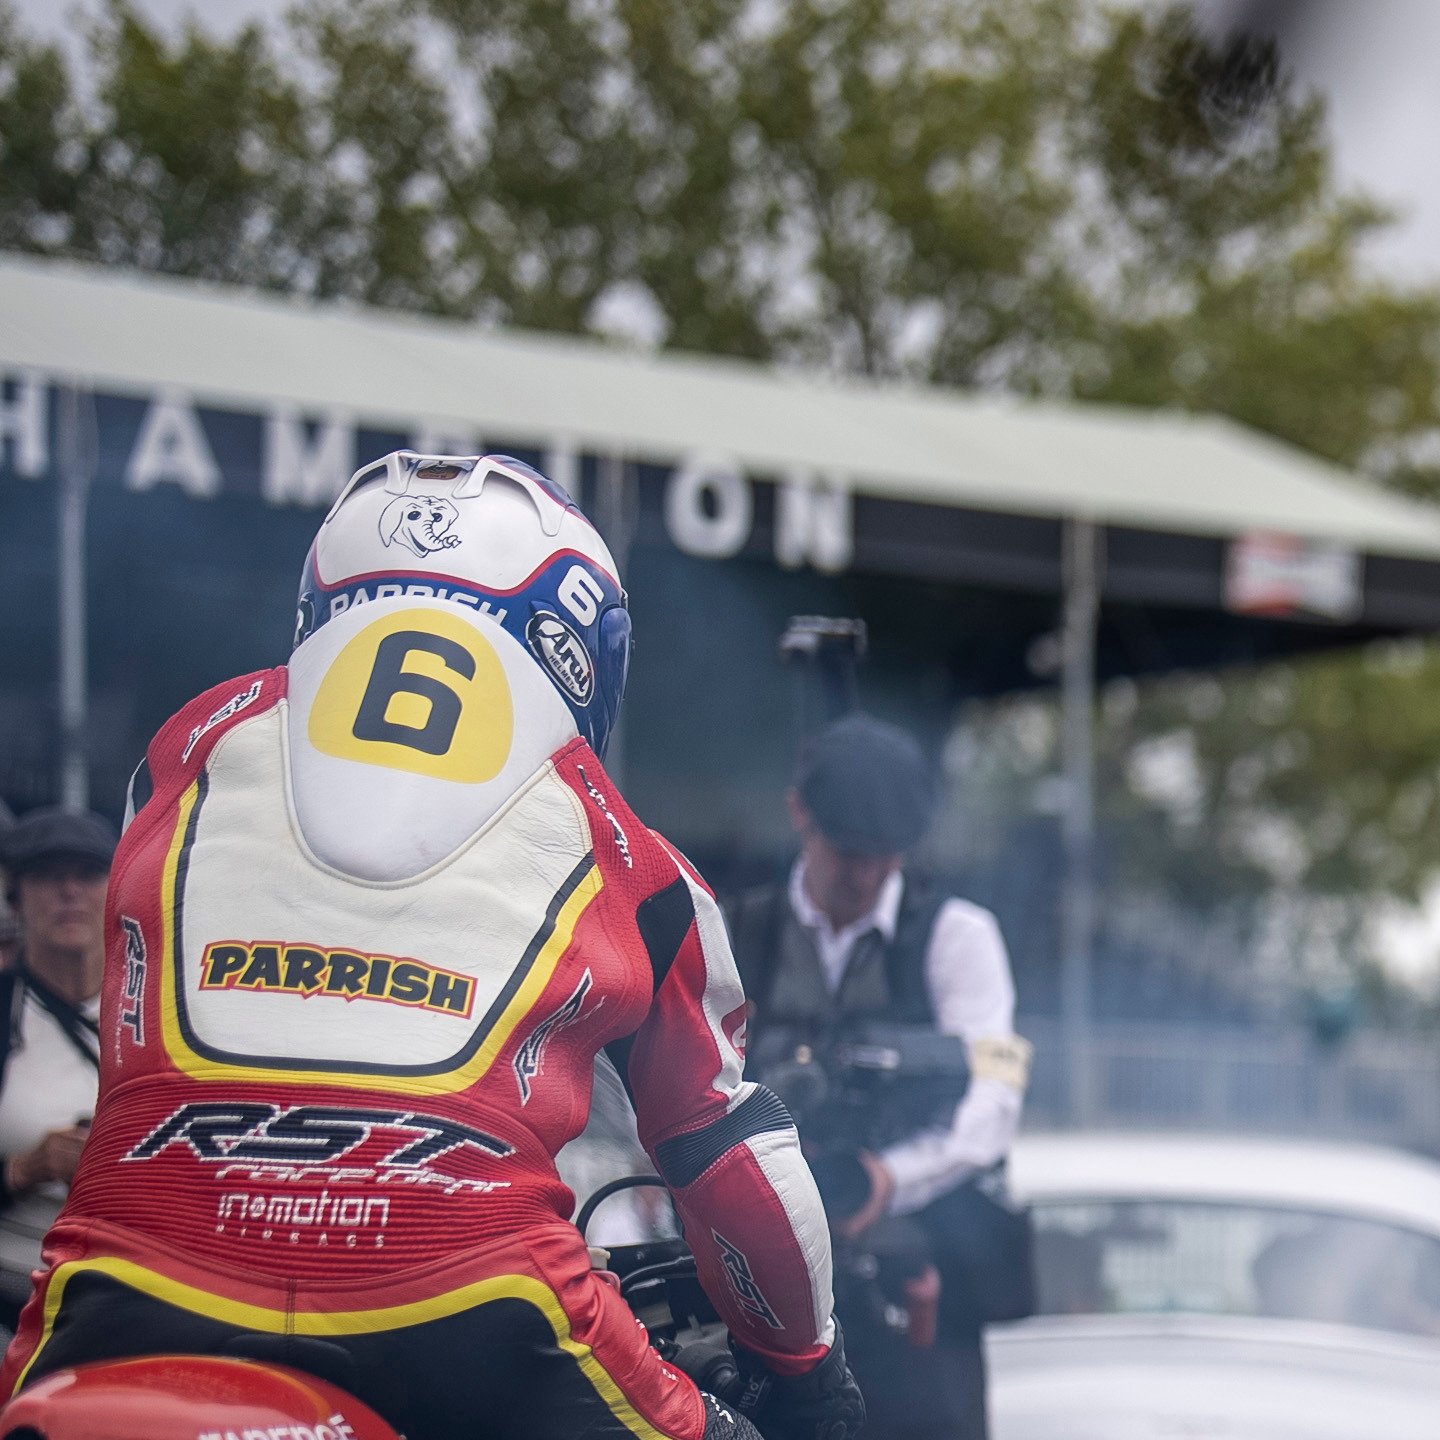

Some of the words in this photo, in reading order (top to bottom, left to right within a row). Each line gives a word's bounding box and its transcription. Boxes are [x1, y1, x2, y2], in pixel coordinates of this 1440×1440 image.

[0, 372, 855, 574] HAMON
[557, 564, 605, 627] 6
[351, 630, 479, 756] 6
[536, 629, 592, 692] Arai
[199, 940, 479, 1018] PARRISH
[119, 1101, 518, 1168] RST
